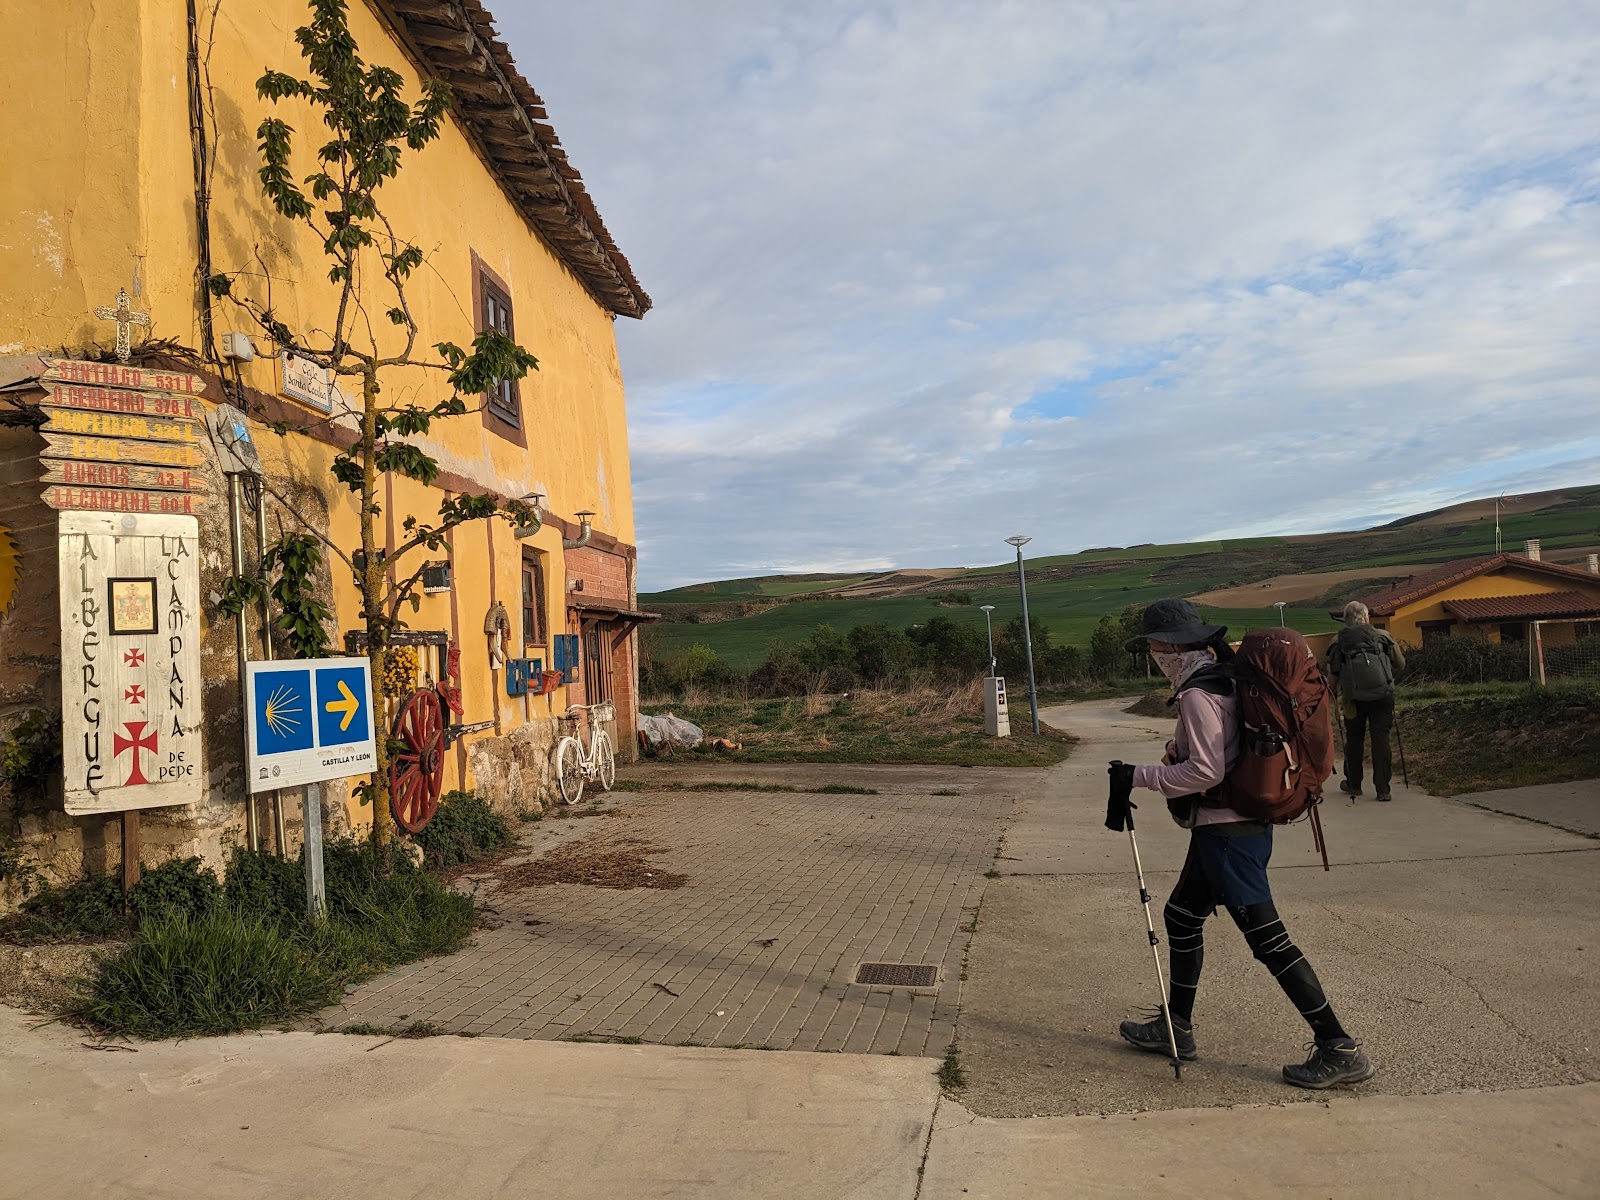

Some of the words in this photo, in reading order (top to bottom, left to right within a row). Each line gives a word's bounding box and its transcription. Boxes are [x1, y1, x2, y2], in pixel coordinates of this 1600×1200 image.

[59, 361, 141, 388] SANTIAGO
[156, 375, 181, 391] 531
[185, 375, 193, 393] K
[288, 374, 306, 391] Santa
[302, 363, 317, 380] Calle
[68, 386, 145, 412] CEBREIRO
[155, 399, 180, 414] 378
[184, 400, 193, 417] K
[51, 410, 149, 438] PONFERRADA
[154, 423, 181, 439] 326
[64, 462, 129, 485] BURGOS
[156, 471, 175, 486] 43
[182, 471, 191, 489] K
[54, 488, 73, 508] LA
[79, 489, 150, 512] CAMPANA
[184, 495, 192, 514] K
[160, 534, 190, 558] LA
[167, 558, 185, 739] CAMPANA
[80, 531, 104, 795] ALBERGUE
[168, 751, 185, 763] DE
[322, 756, 350, 766] CASTILLA
[356, 752, 370, 761] LEÓN
[159, 765, 194, 780] PEPE
